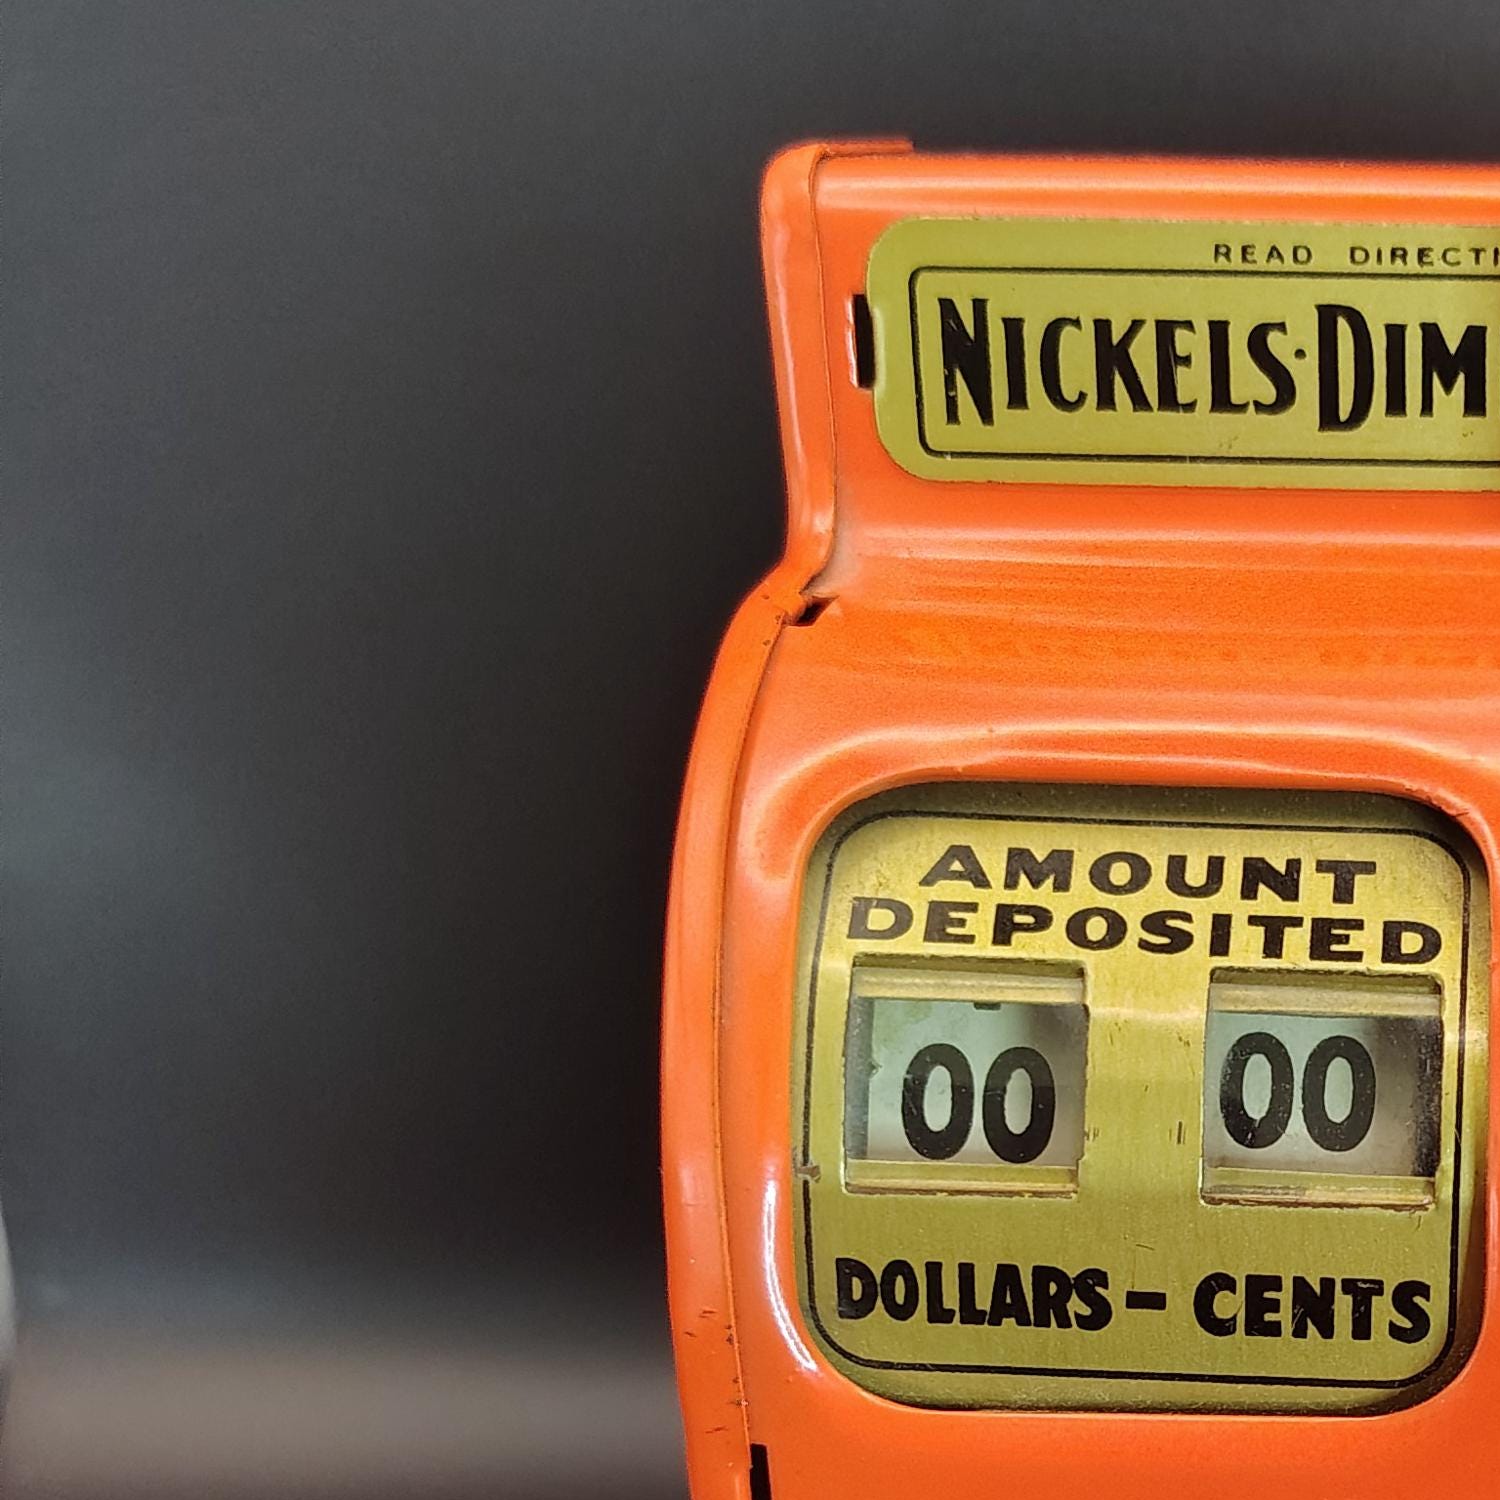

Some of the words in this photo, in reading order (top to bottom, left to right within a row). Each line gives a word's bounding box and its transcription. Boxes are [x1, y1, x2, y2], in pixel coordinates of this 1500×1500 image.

[1213, 243, 1313, 266] READ
[919, 844, 1377, 905] AMOUNT
[846, 897, 1444, 965] DEPOSITED
[901, 1042, 1056, 1164] 00
[1219, 1031, 1376, 1153] 00
[834, 1257, 1113, 1331] DOLLARS
[1193, 1273, 1431, 1344] CENTS
